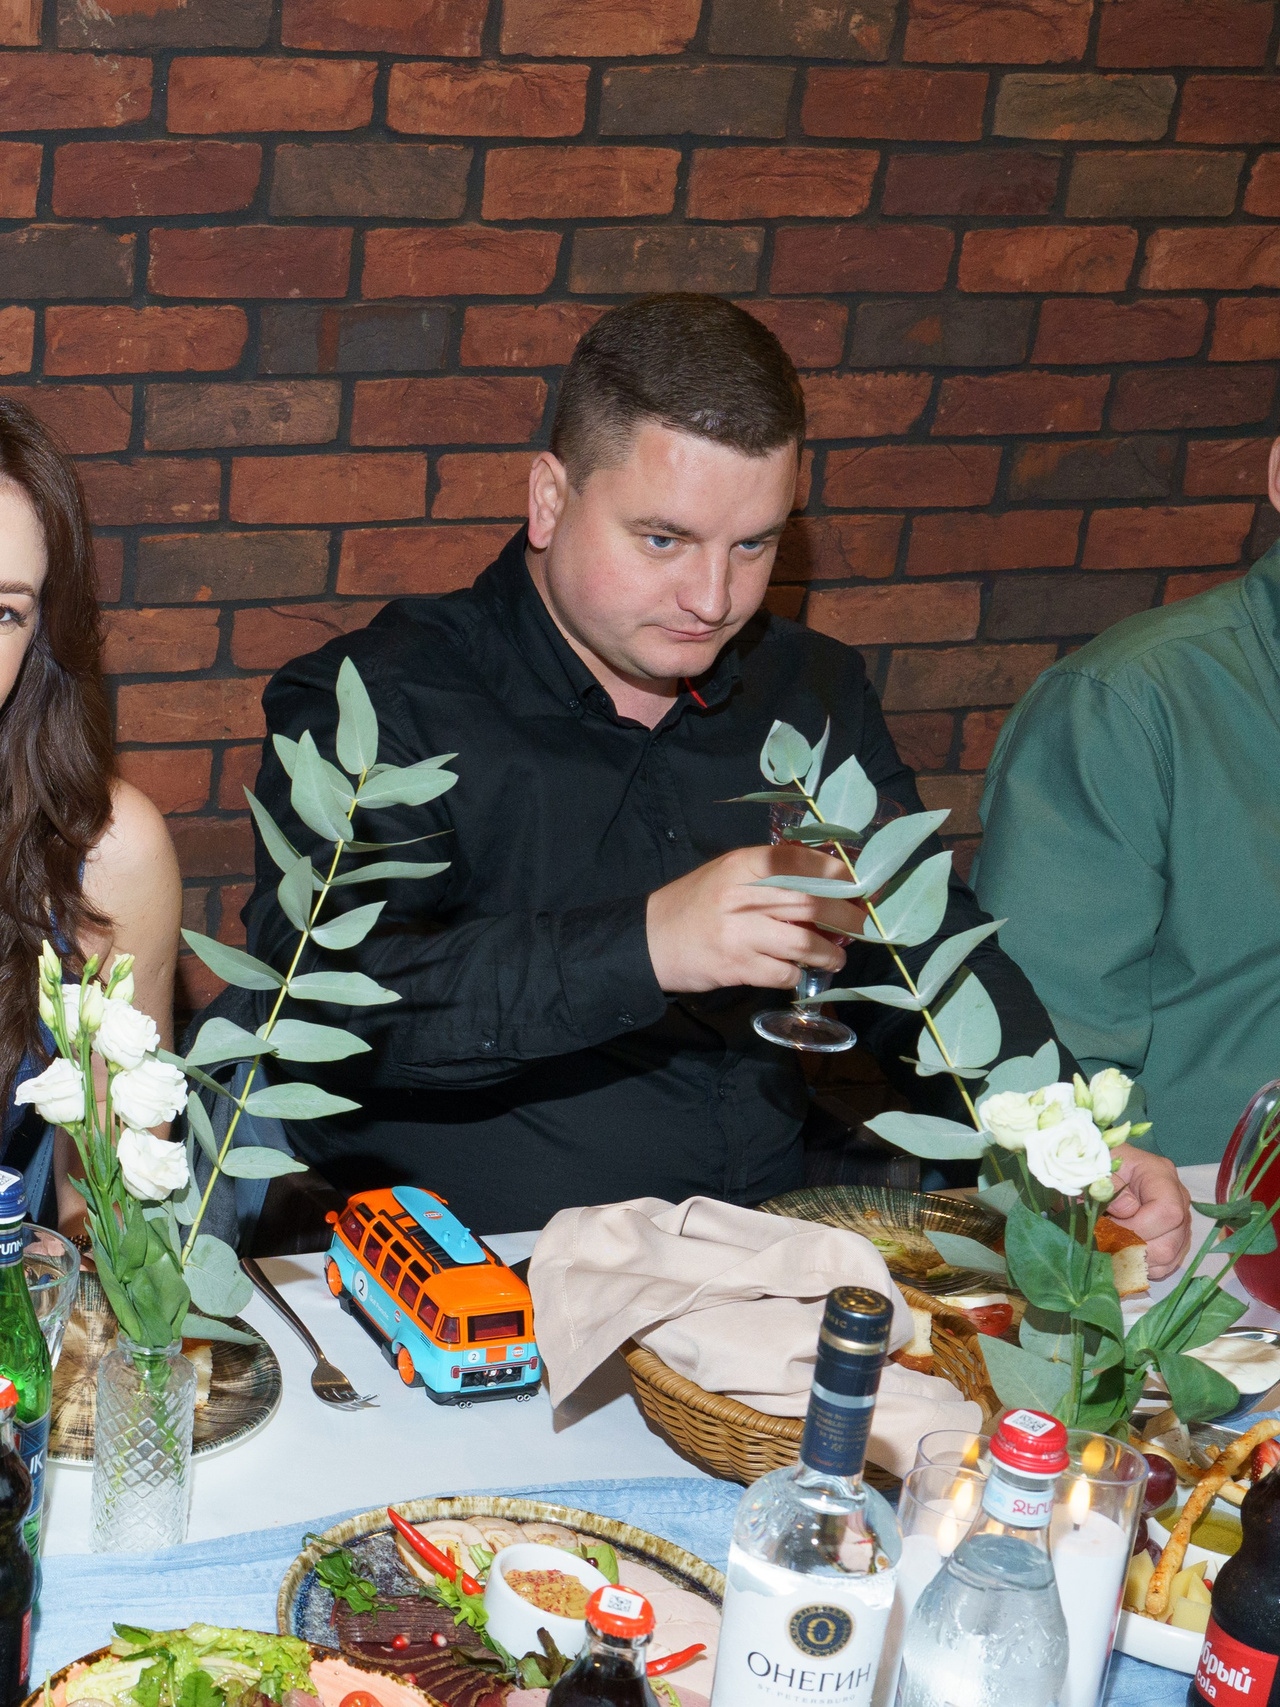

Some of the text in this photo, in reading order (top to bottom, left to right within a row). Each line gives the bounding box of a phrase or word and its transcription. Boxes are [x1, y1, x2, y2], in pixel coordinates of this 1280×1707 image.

[358, 1278, 366, 1297] 2
[747, 1651, 872, 1693] ОНЕГИН
[1197, 1669, 1217, 1699] cola
[1200, 1640, 1252, 1694] брый
